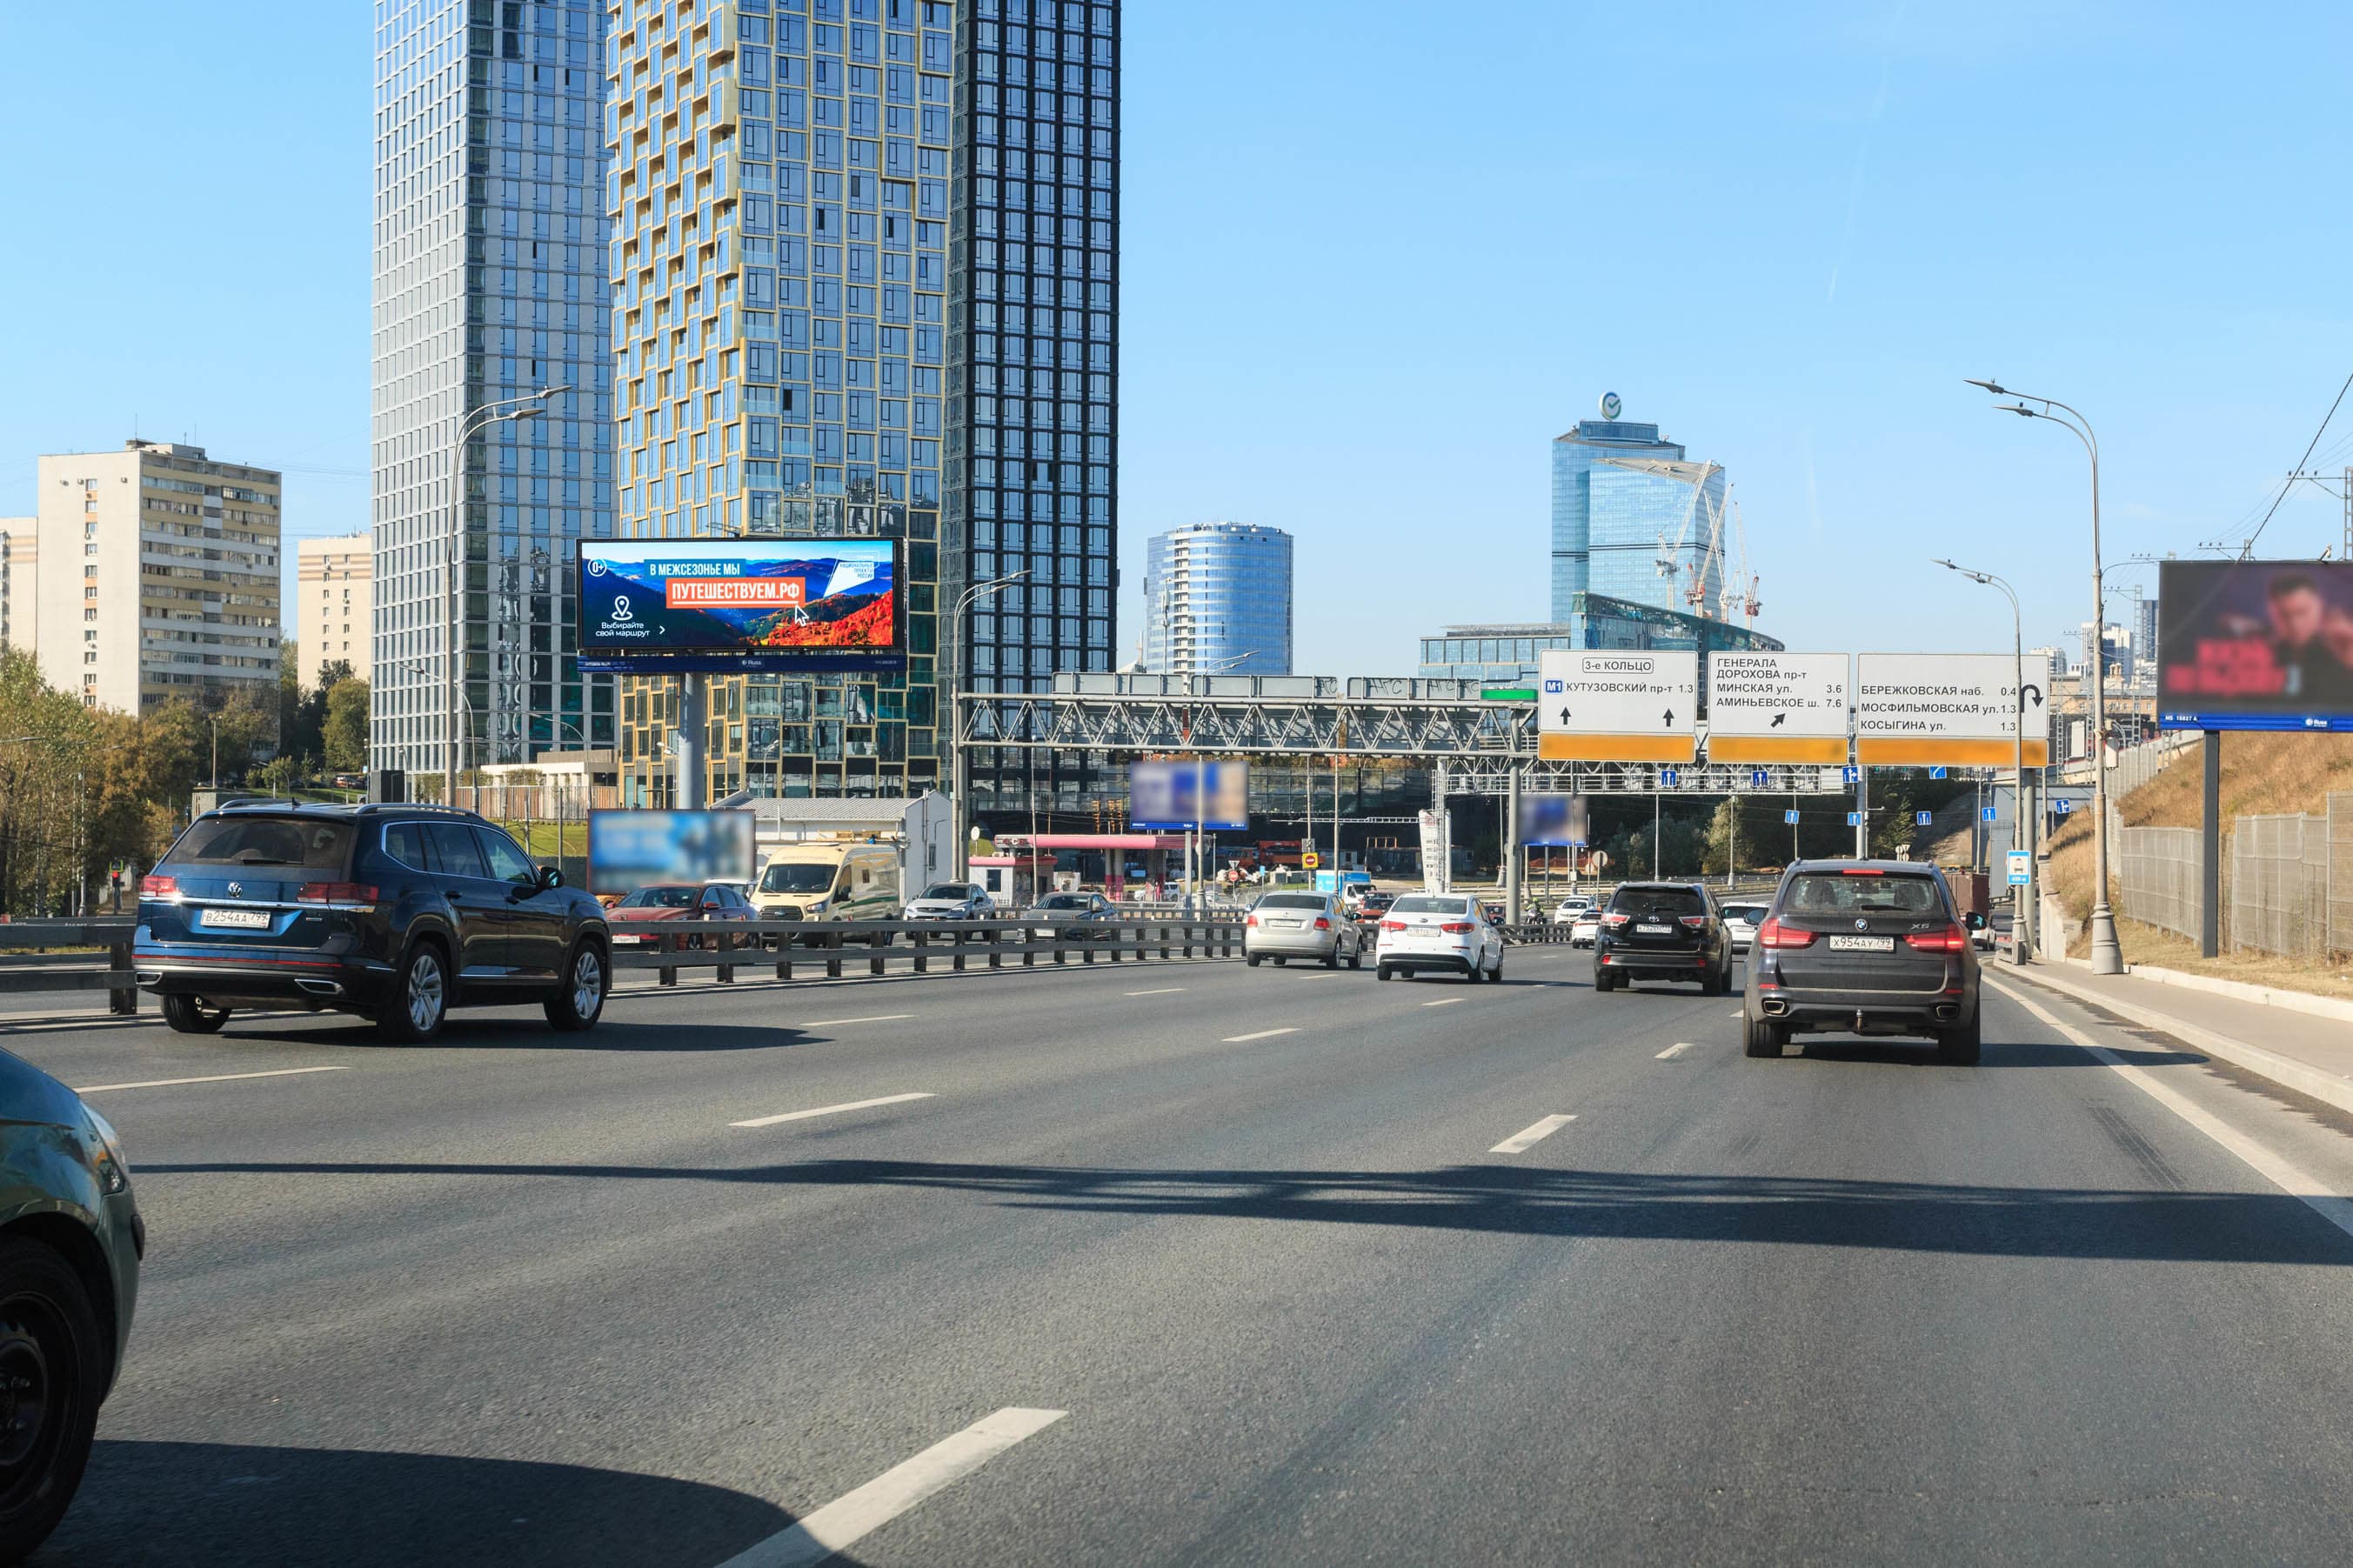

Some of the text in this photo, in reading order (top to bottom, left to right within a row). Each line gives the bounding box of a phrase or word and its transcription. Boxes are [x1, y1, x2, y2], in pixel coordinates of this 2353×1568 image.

[650, 563, 740, 576] В МЕЖСЕЗОНЬЕ МЫ
[672, 583, 799, 599] ПУТЕШЕСТВУЕМ.РФ
[1585, 661, 1652, 671] 3-е КОЛЬЦО
[1717, 658, 1777, 668] ГЕНЕРАЛА
[1716, 670, 1781, 679] ДОРОХОВА
[1567, 682, 1647, 692] КУТУЗОВСКИЙ
[1650, 685, 1673, 695] пр-т
[1678, 684, 1695, 694] 1.3
[1717, 684, 1842, 695] МИНСКАЯ ул. 3.6
[1862, 685, 2016, 697] БЕРЕЖКОВСКАЯ наб. 0.4
[1716, 697, 1804, 708] АМИНЬЕВСКОЕ
[1827, 698, 1842, 708] 7.6
[1861, 703, 2016, 716] МОСФИЛЬМОВСКАЯ ул. 1.3
[1861, 720, 2016, 732] КОСЫГИНА ул. 1.3
[1875, 937, 1890, 946] 799
